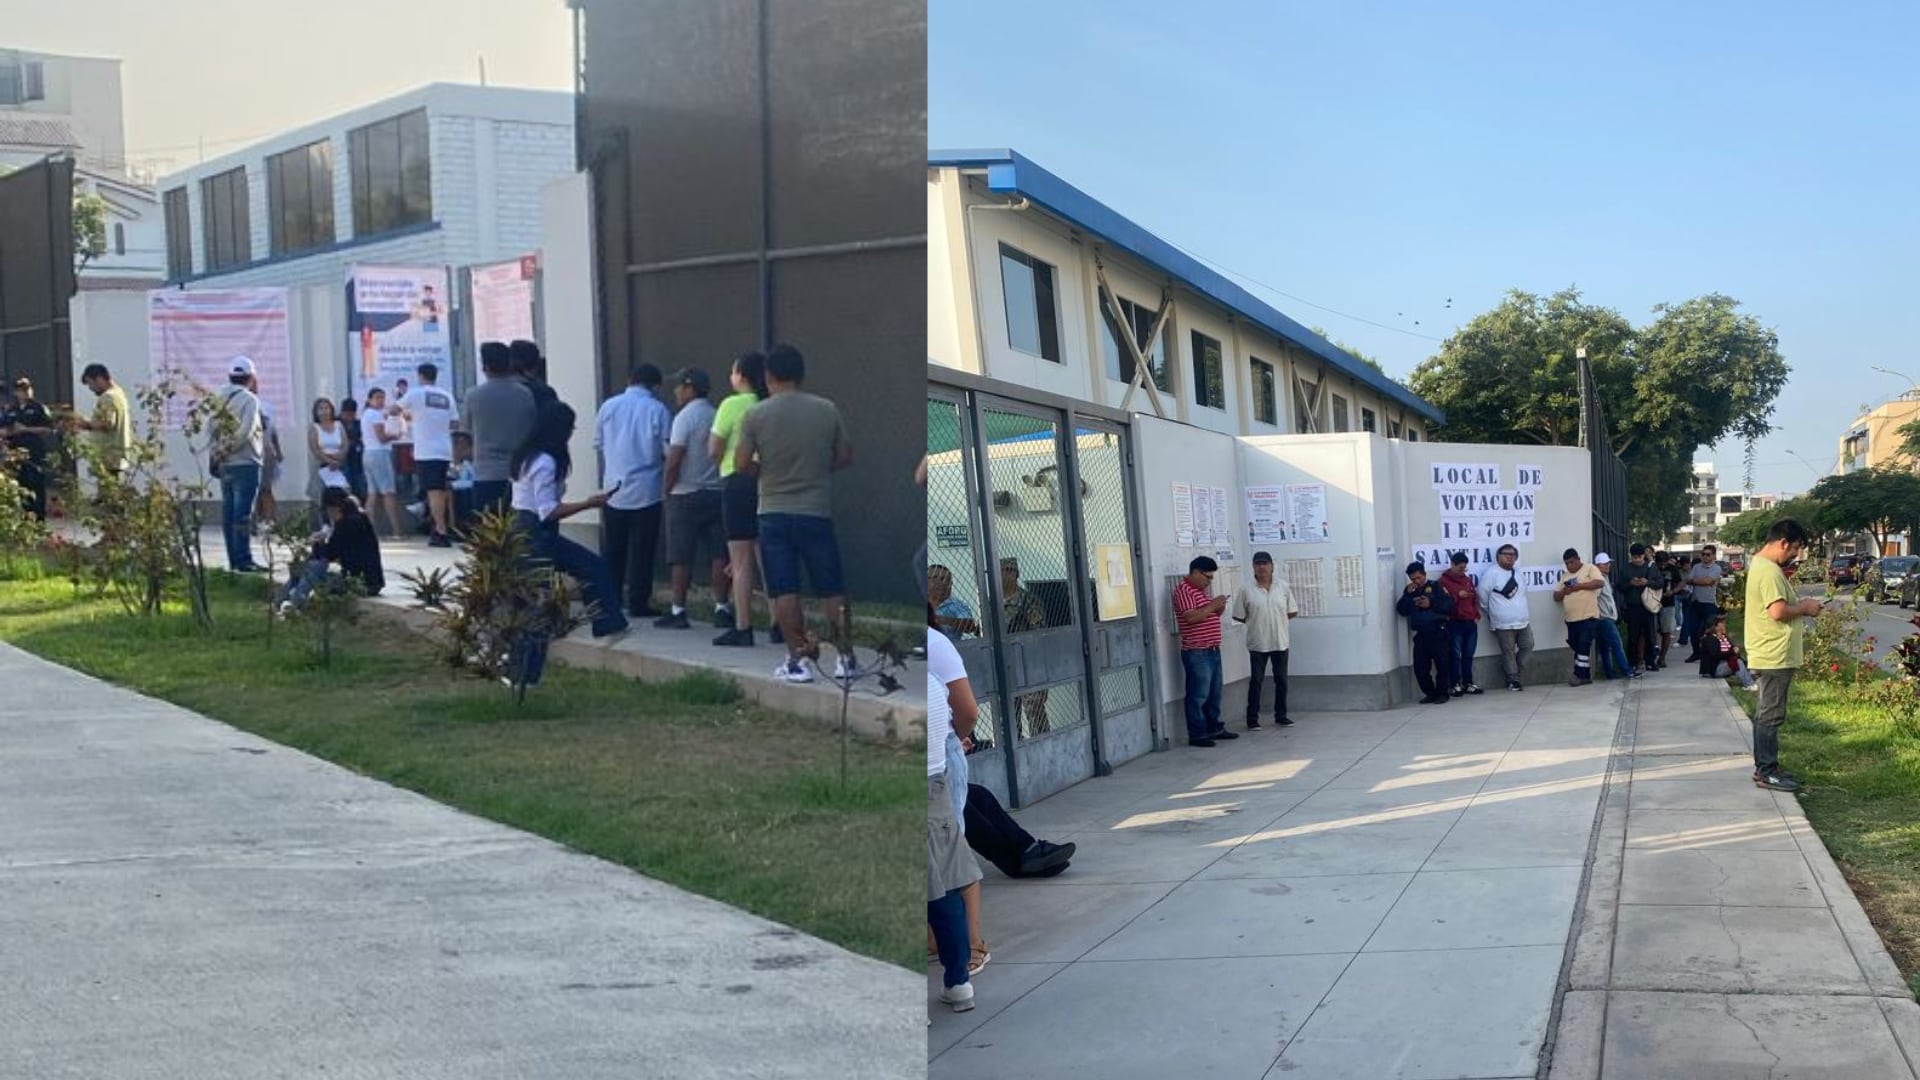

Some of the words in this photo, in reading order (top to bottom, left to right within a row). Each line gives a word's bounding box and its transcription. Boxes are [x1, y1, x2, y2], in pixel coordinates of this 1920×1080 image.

[1433, 467, 1498, 484] LOCAL
[1519, 469, 1542, 486] DE
[1441, 491, 1534, 511] VOTACIÓN
[1443, 522, 1468, 539] IE
[1485, 521, 1531, 538] 7087
